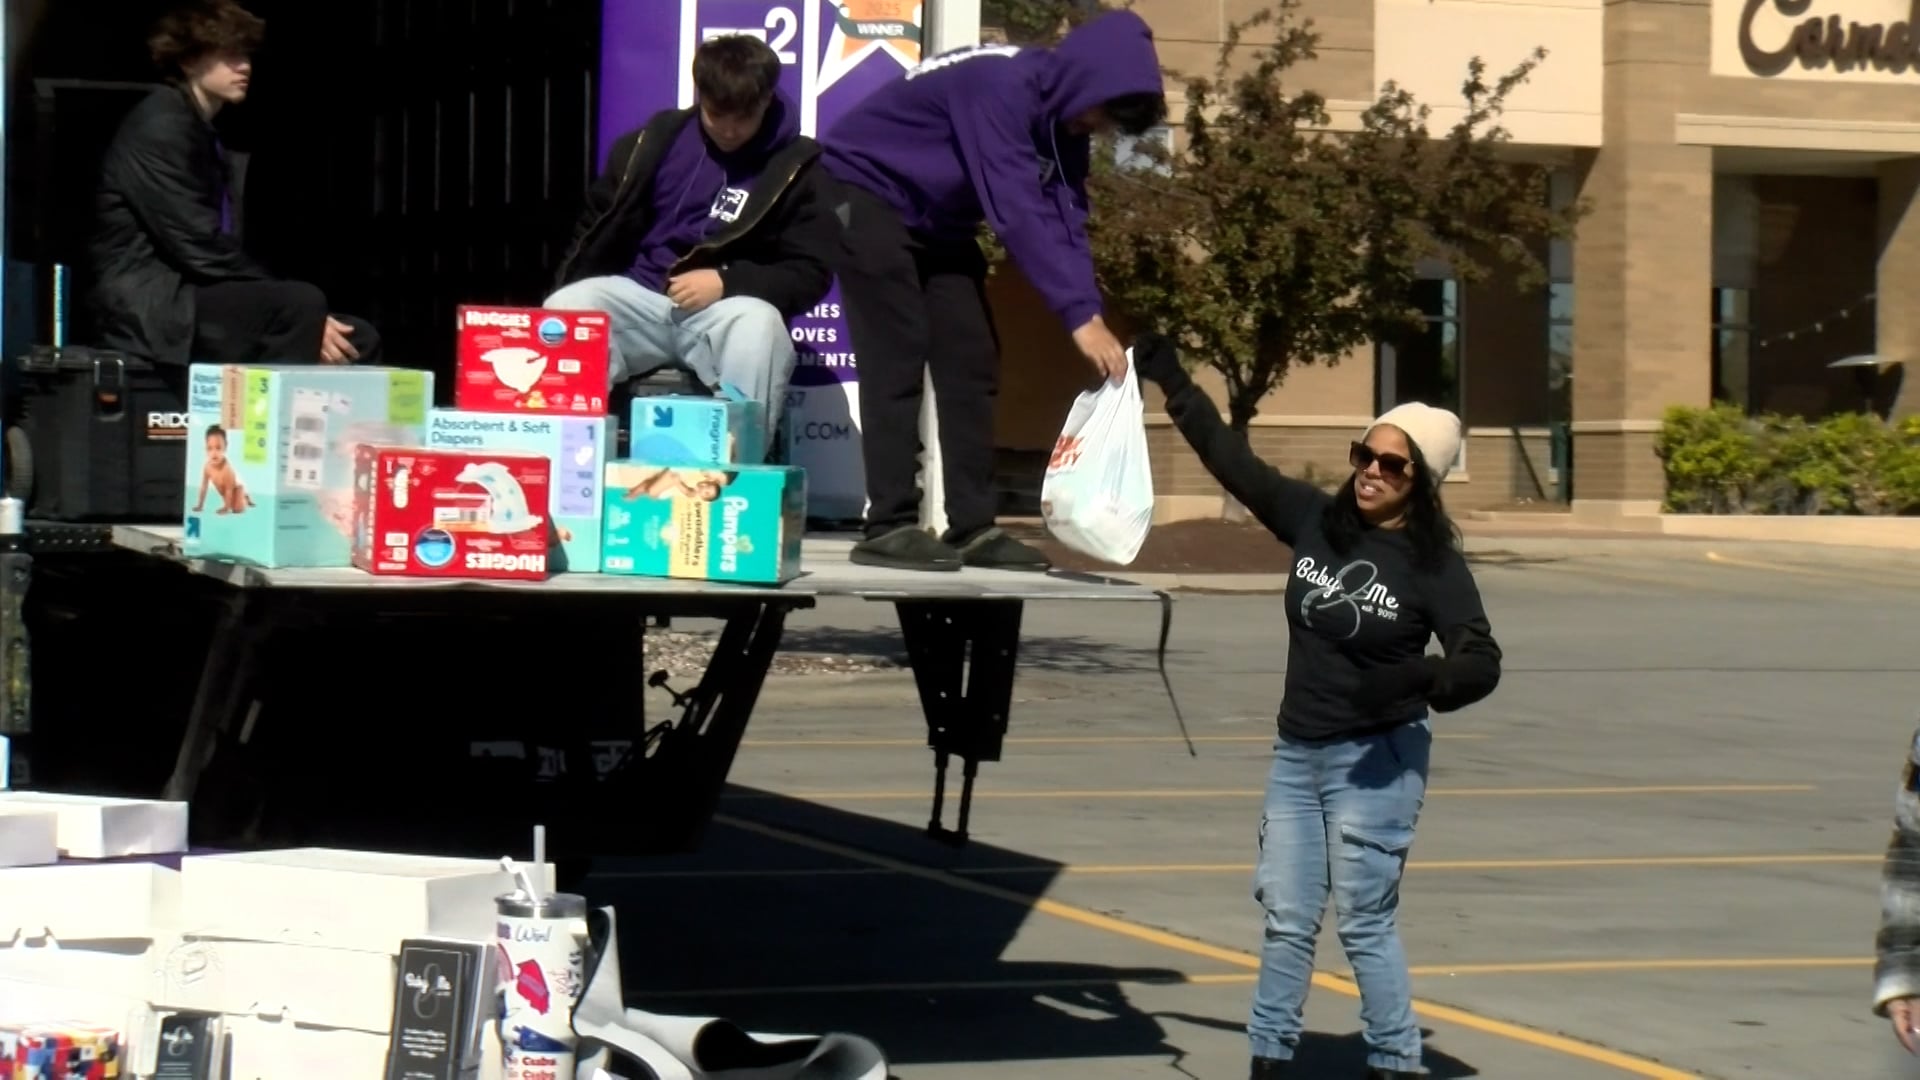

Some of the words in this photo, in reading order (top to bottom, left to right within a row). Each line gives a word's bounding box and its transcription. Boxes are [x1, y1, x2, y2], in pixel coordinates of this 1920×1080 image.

[857, 23, 905, 36] WINNER
[465, 311, 531, 328] HUGGIES
[260, 377, 269, 394] 3
[432, 417, 504, 432] Absorbent
[508, 422, 517, 432] &
[522, 421, 551, 434] Soft
[586, 425, 595, 440] 1
[431, 432, 484, 447] Diapers
[718, 496, 749, 573] Pampers
[465, 553, 546, 572] HUGGIES
[1296, 557, 1341, 599] Baby
[1363, 583, 1399, 609] Me
